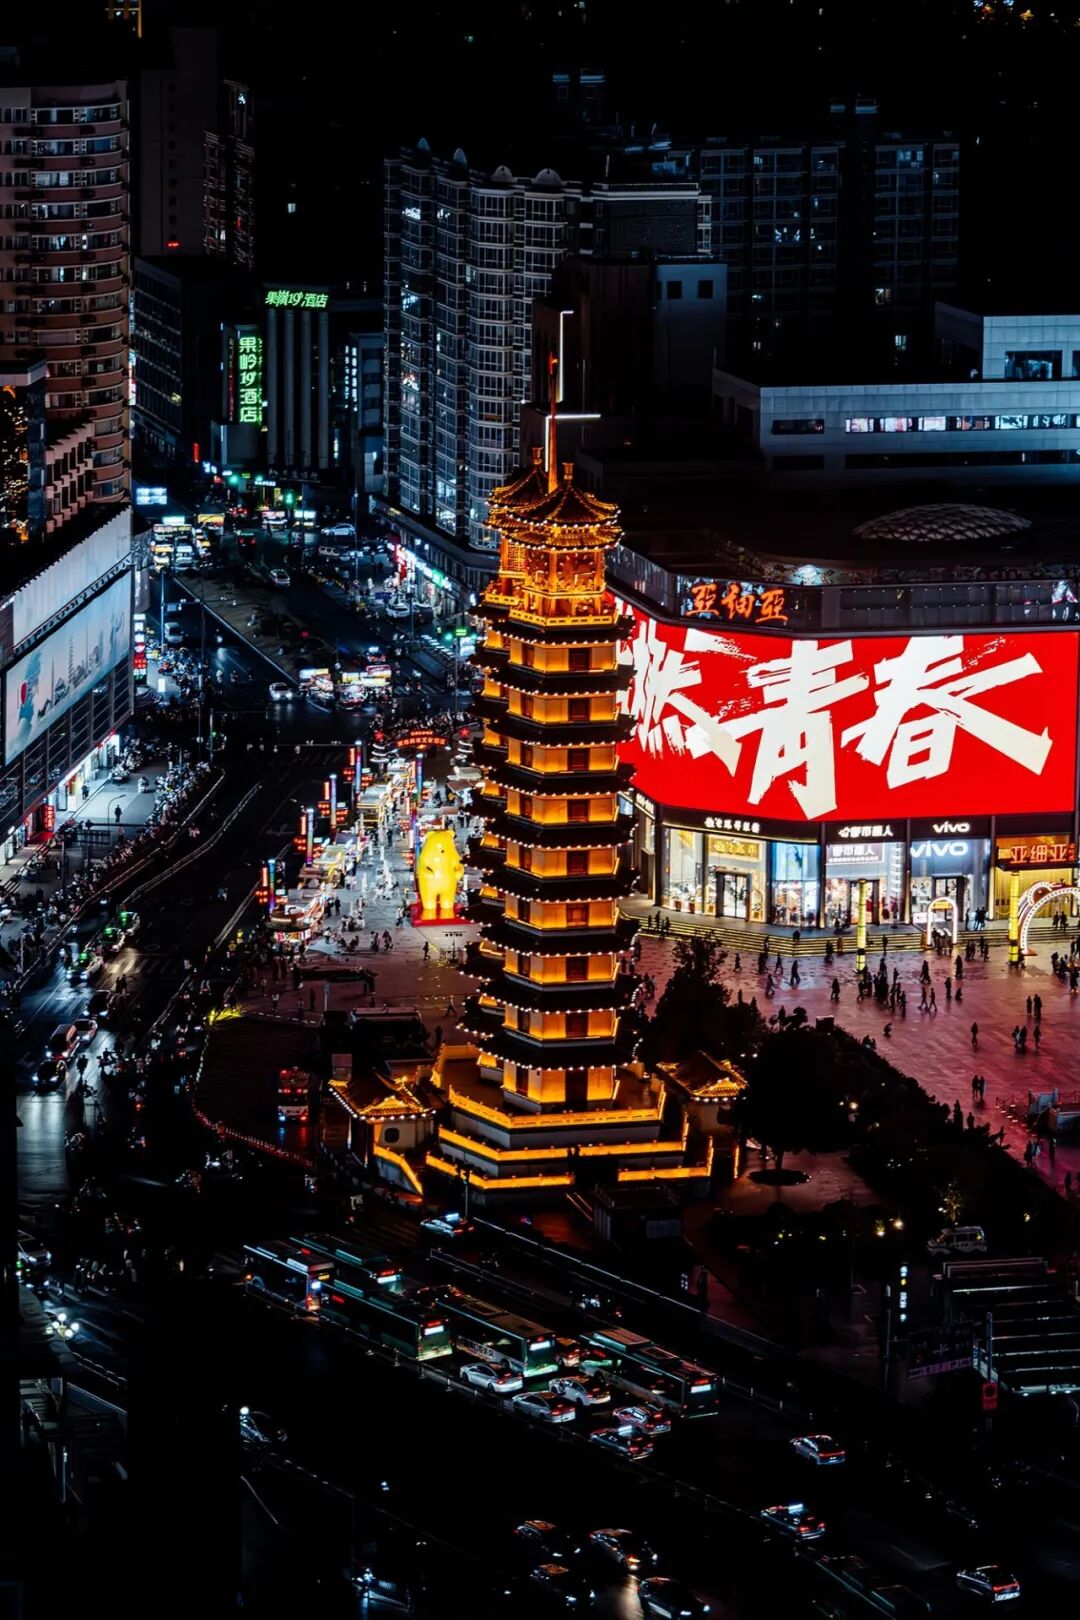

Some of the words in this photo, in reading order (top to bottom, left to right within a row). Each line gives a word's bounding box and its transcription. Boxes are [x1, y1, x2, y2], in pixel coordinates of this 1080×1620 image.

[932, 821, 971, 834] vivo
[910, 840, 969, 858] vivo
[1010, 843, 1068, 864] 亚细亚
